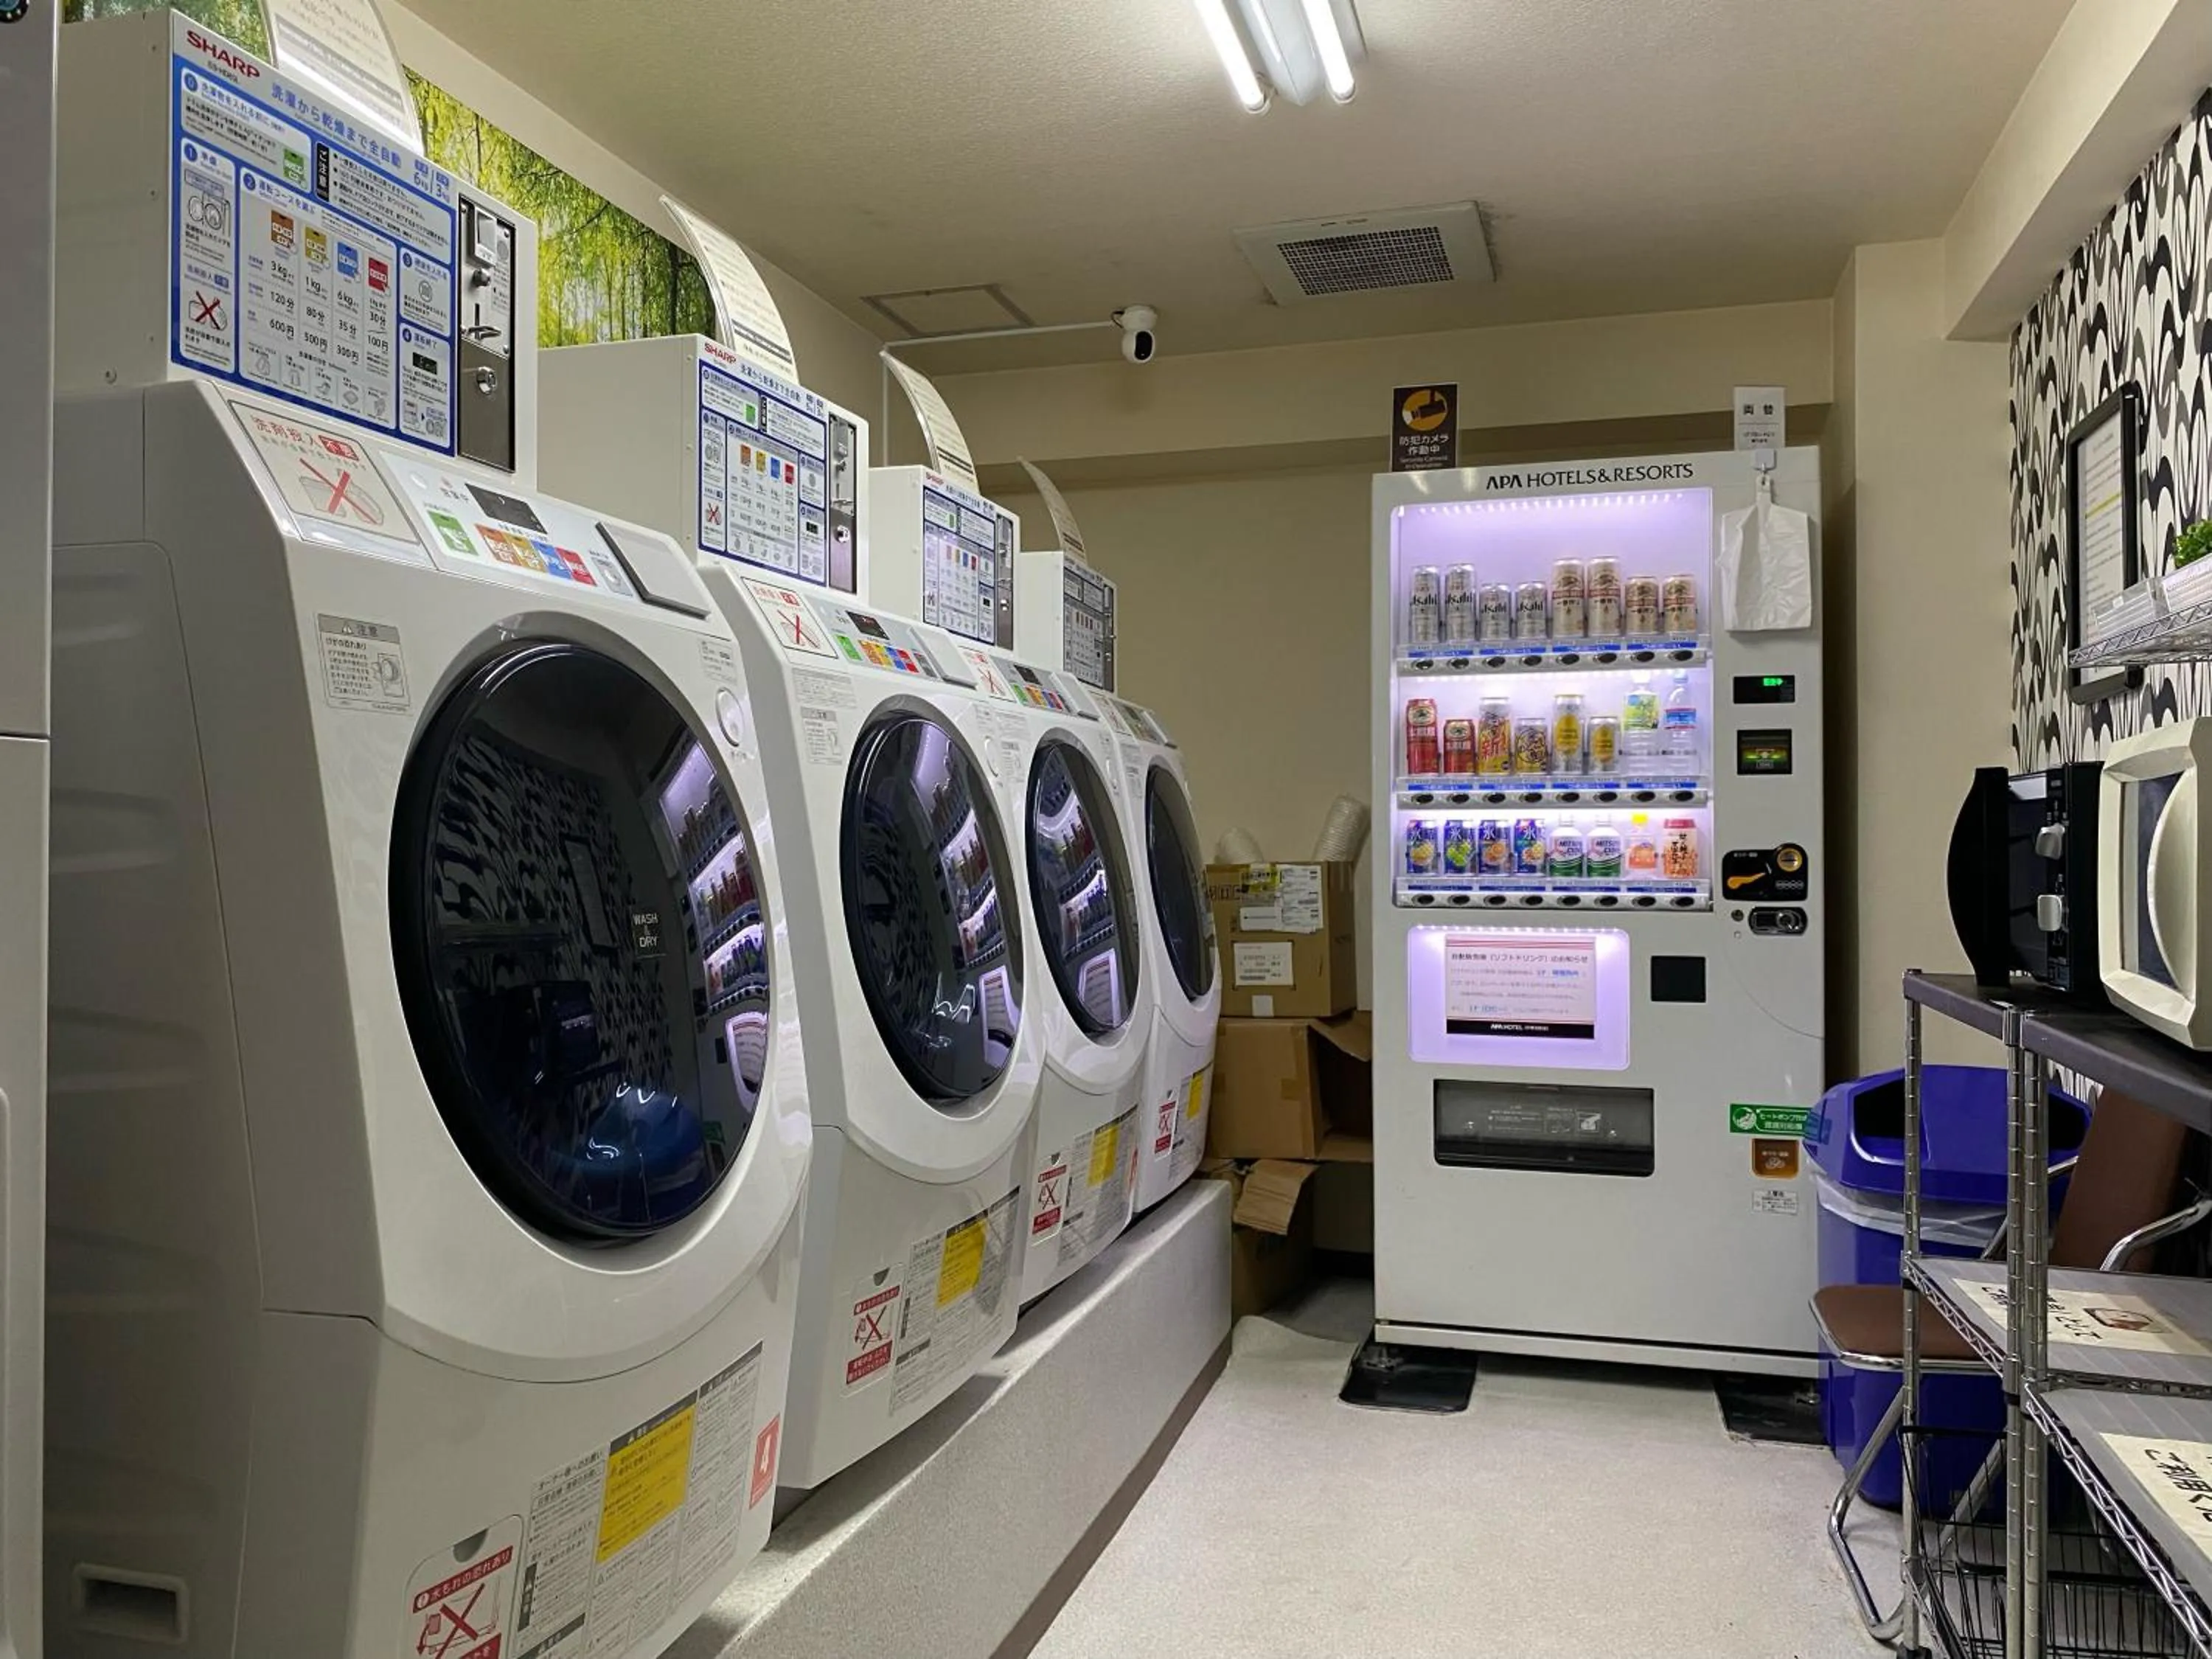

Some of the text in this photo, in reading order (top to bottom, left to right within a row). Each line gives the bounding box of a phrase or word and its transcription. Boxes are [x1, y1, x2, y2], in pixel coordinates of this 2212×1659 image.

[187, 29, 260, 78] SHARP
[269, 319, 294, 337] 600円
[305, 332, 327, 351] 500円
[368, 335, 389, 352] 100円
[337, 344, 359, 362] 300円
[704, 343, 736, 364] SHARP
[1399, 434, 1449, 446] 防犯カメラ
[1486, 475, 1523, 490] APA
[1410, 593, 1437, 606] Asahi
[1445, 591, 1472, 605] Asahi
[1481, 602, 1507, 614] Asahi
[1517, 601, 1543, 613] Asahi
[633, 913, 658, 925] WASH
[639, 936, 658, 947] DRY
